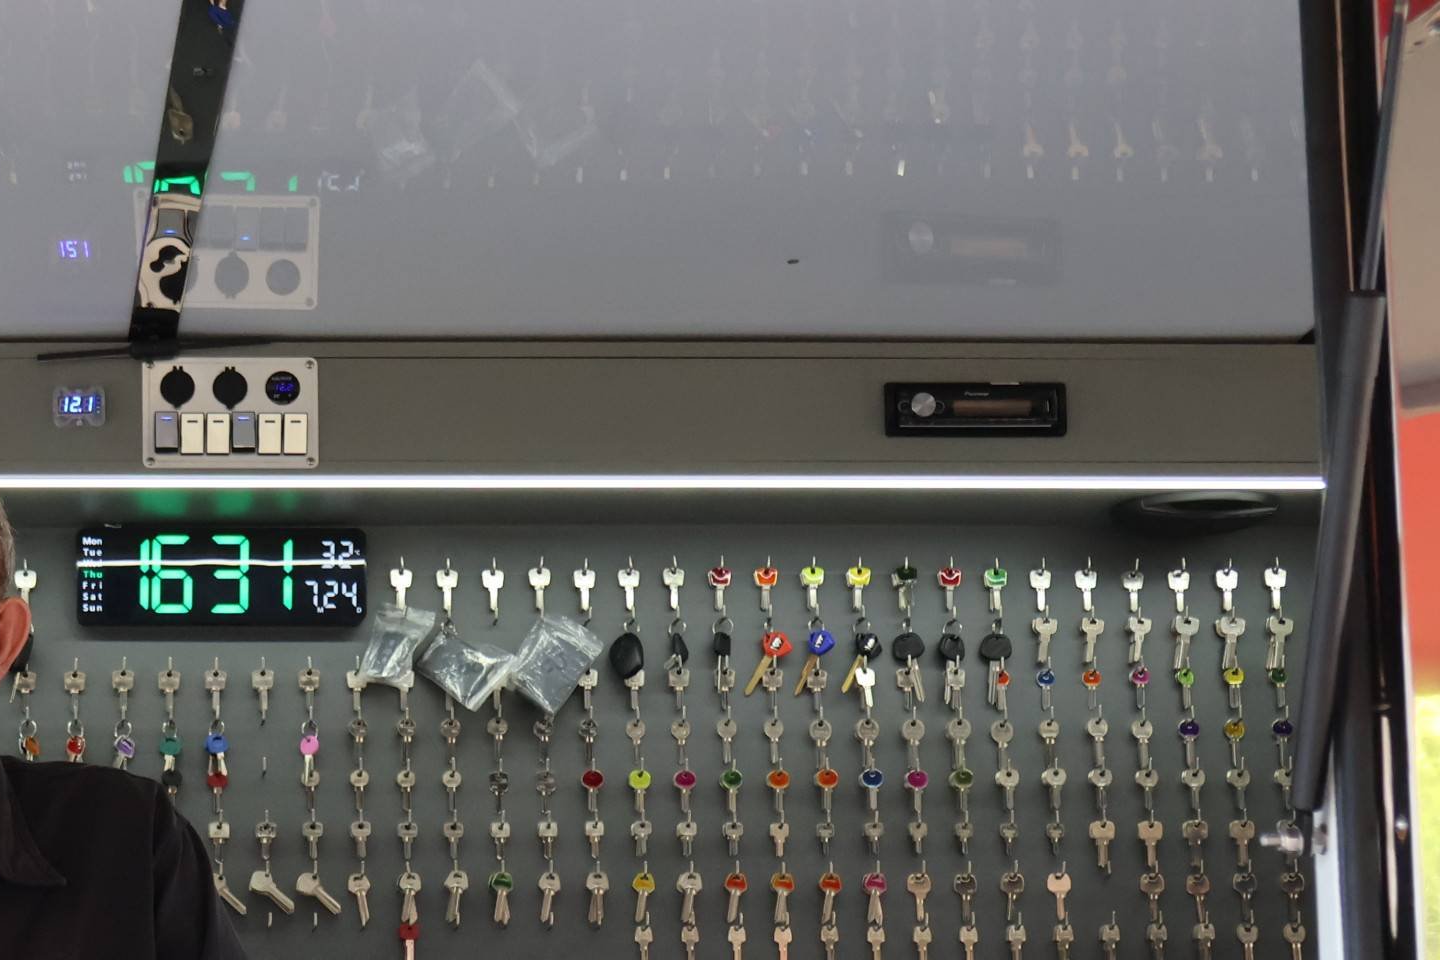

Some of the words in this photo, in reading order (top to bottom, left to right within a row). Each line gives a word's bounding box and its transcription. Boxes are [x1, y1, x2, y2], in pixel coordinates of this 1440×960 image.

[64, 396, 93, 413] 12.1
[82, 536, 103, 546] Mon
[82, 548, 103, 557] Tue
[82, 570, 103, 579] Thu
[82, 581, 103, 590] Fri
[82, 592, 103, 601] Sat
[82, 603, 103, 612] Sun
